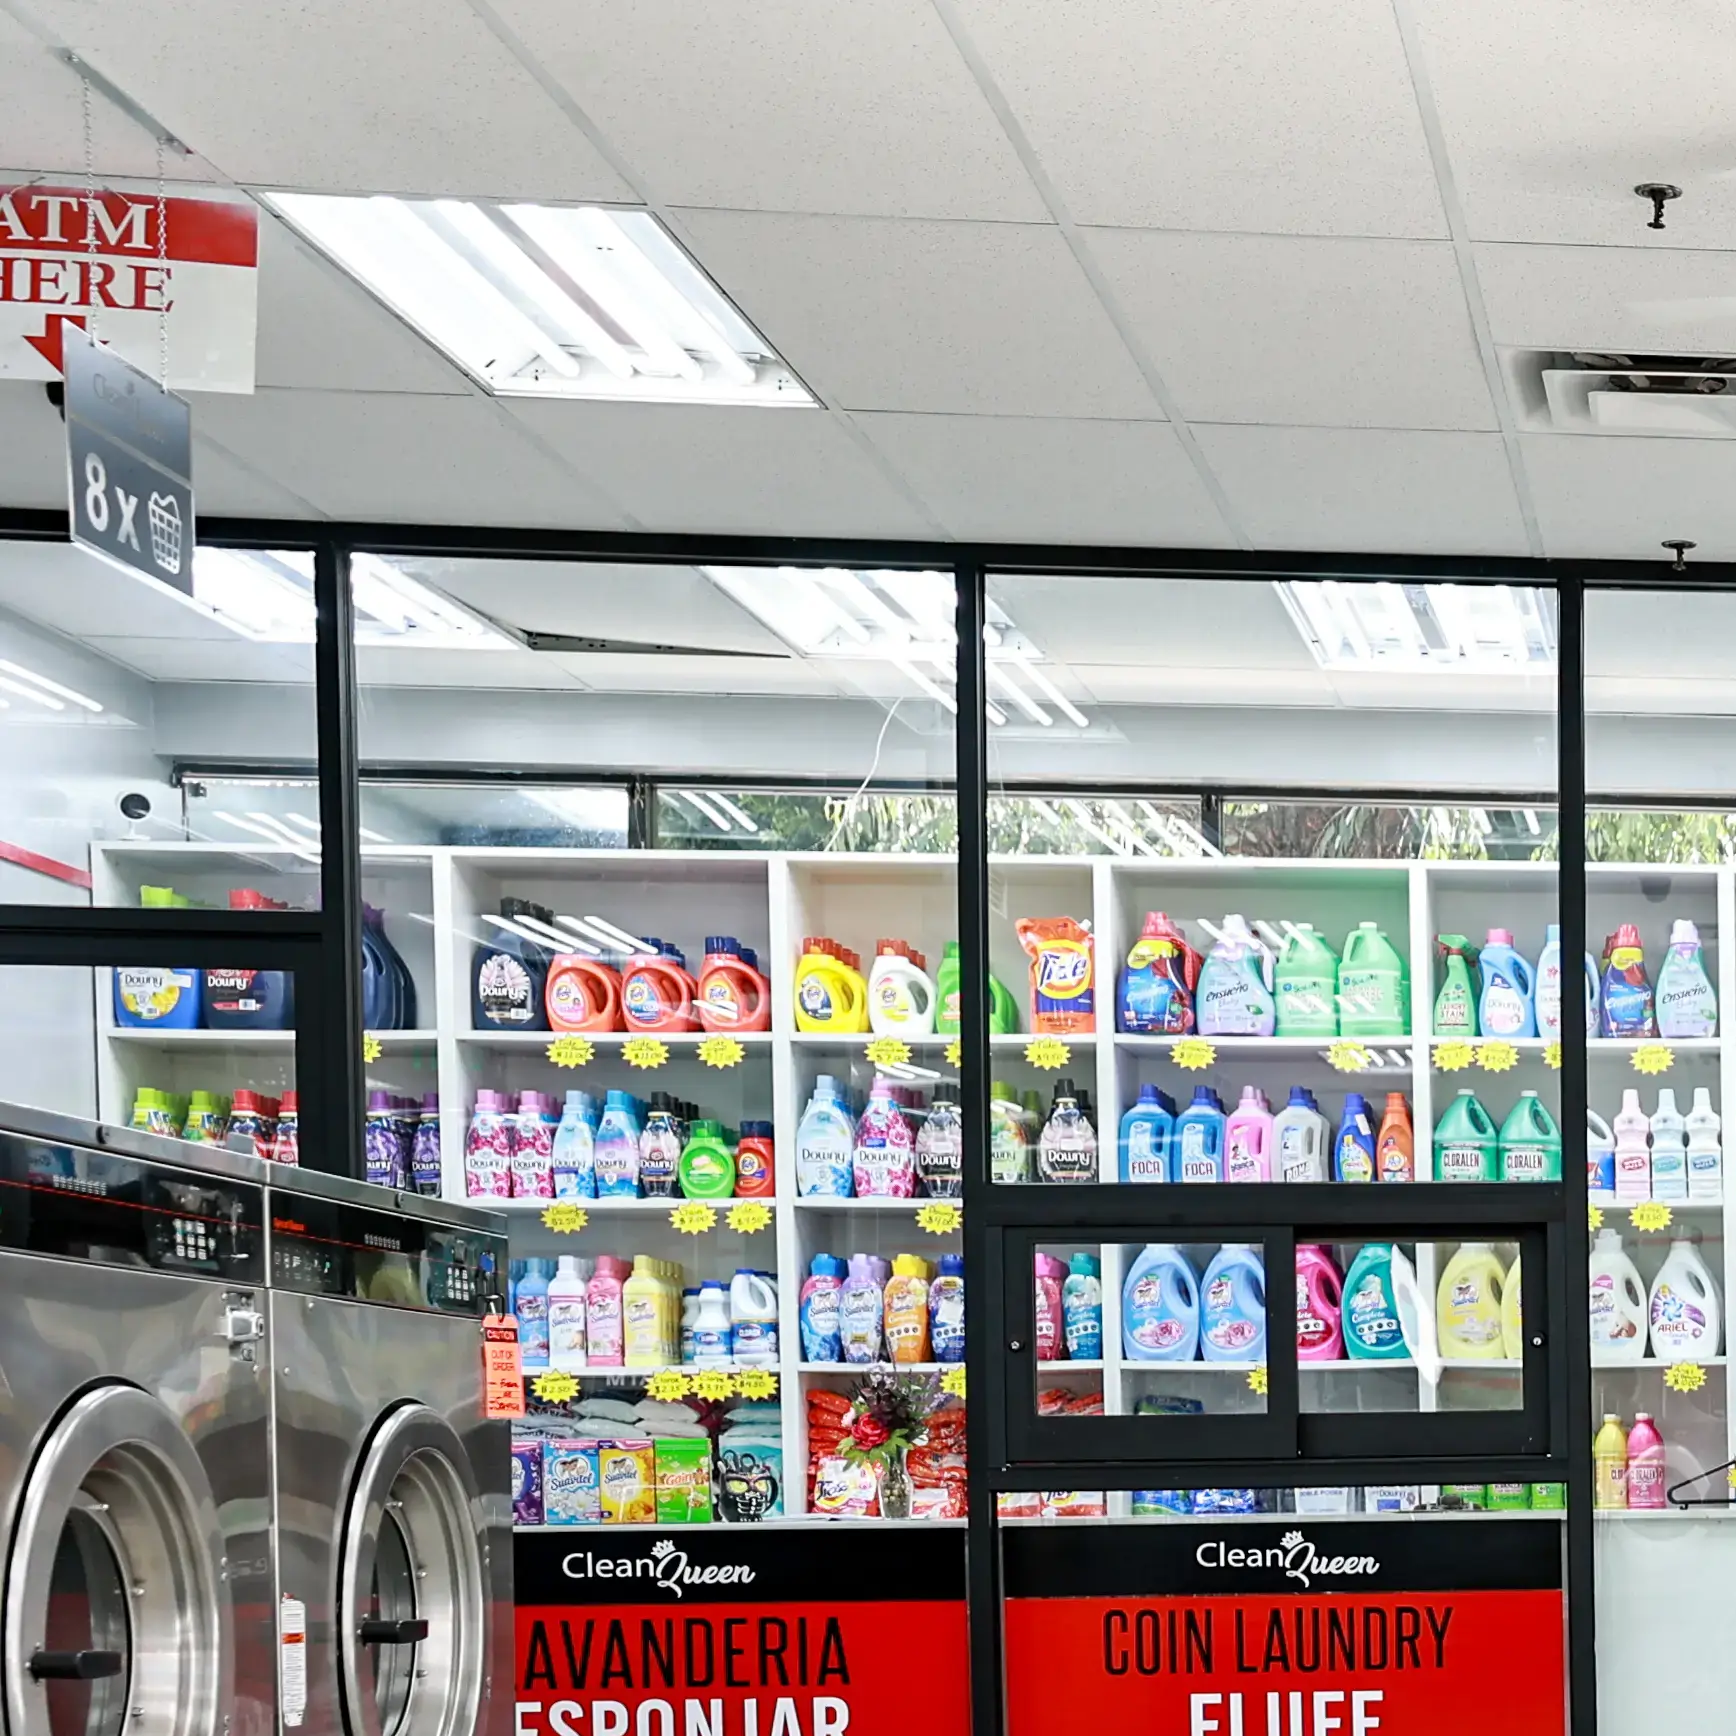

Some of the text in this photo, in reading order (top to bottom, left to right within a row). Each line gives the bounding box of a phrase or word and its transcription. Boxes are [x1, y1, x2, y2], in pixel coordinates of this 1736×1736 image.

[0, 194, 155, 250] ATM
[85, 452, 109, 532] 8
[1038, 951, 1088, 988] Tide
[125, 974, 163, 988] Downy
[207, 975, 248, 991] Downy
[481, 985, 520, 999] Downy
[470, 1158, 504, 1170] Downy
[555, 1158, 586, 1169] Downy
[596, 1158, 627, 1169] Downy
[802, 1149, 845, 1164] Downy
[859, 1149, 901, 1164] Downy
[920, 1152, 962, 1167] Downy
[1048, 1149, 1091, 1166] Downy
[1443, 1151, 1480, 1168] CLORALEN
[1506, 1153, 1543, 1169] CLORALEN
[513, 1158, 546, 1171] Downy
[640, 1158, 673, 1171] Downy
[1131, 1160, 1161, 1175] FOCA
[1185, 1162, 1214, 1177] FOCA
[1657, 1322, 1689, 1333] ARIEL
[550, 1472, 593, 1491] Suavitel
[603, 1470, 638, 1484] Suavitel
[663, 1471, 694, 1486] Gain
[1103, 1605, 1454, 1676] COIN LAUNDRY
